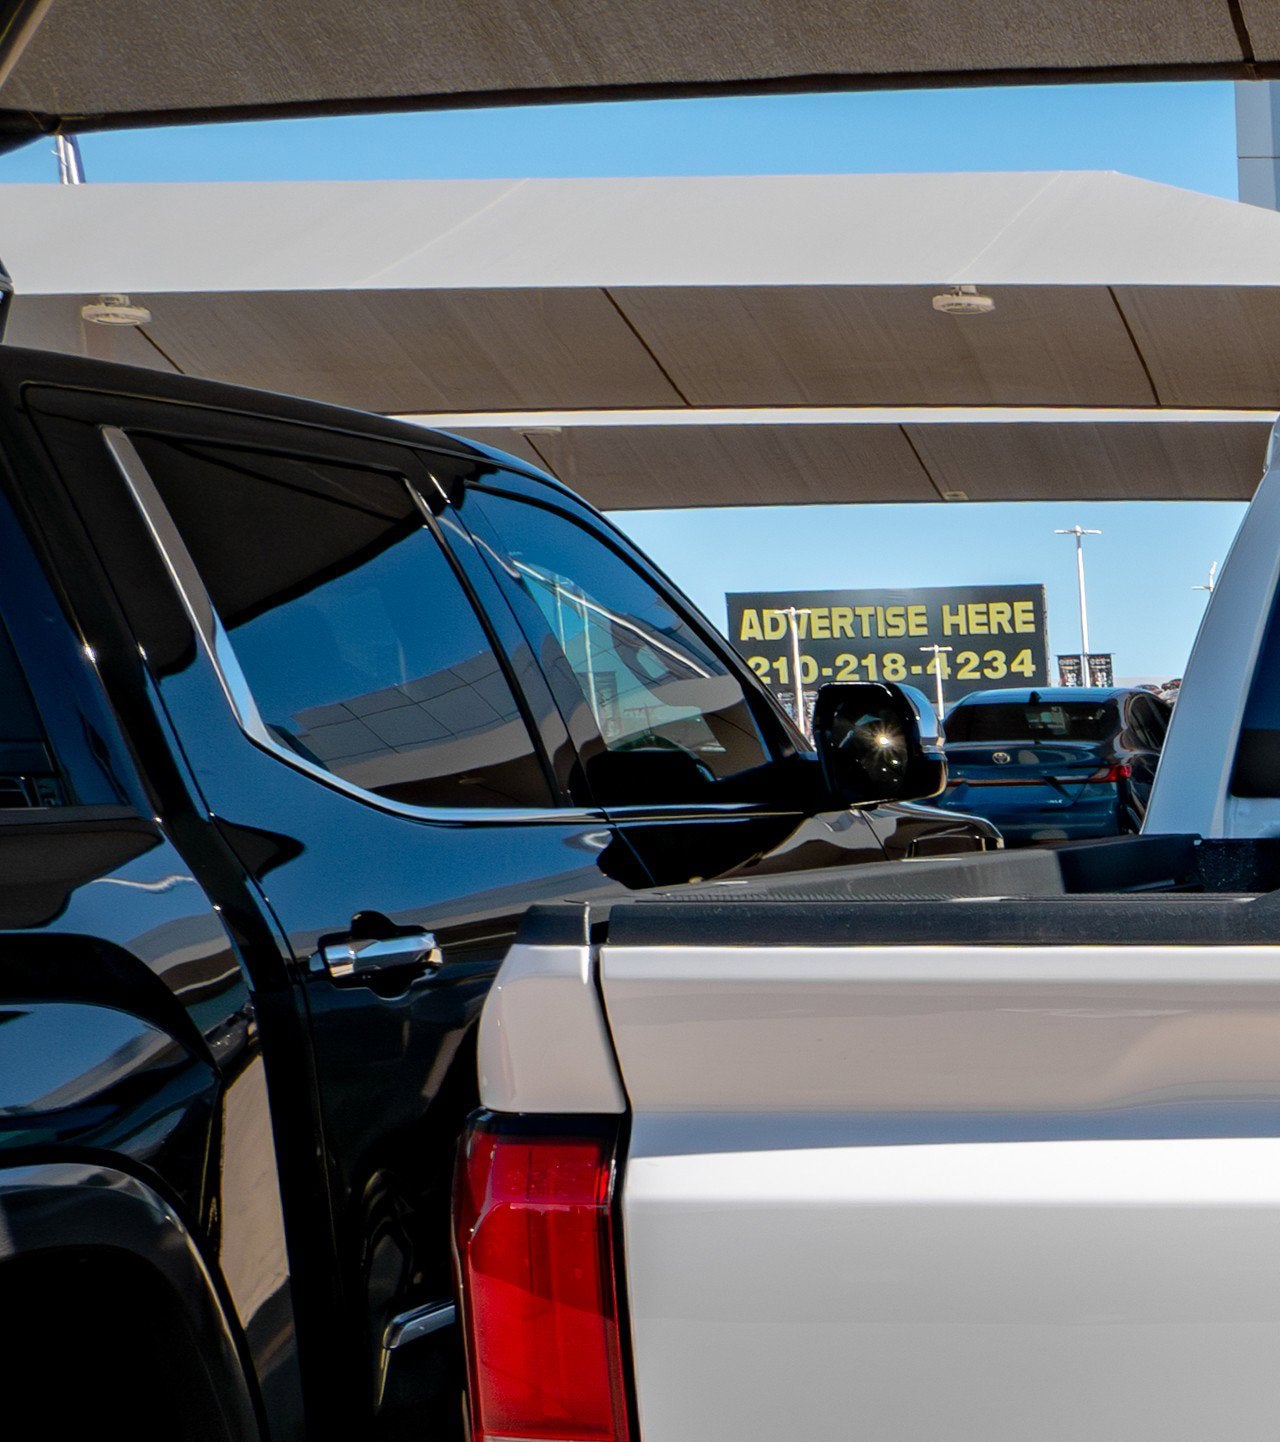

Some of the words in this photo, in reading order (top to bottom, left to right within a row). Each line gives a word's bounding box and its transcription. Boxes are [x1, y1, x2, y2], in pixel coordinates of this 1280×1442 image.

[740, 605, 928, 641] ADVERTISE
[942, 601, 1036, 636] HERE
[747, 648, 1036, 685] 210-218-4234
